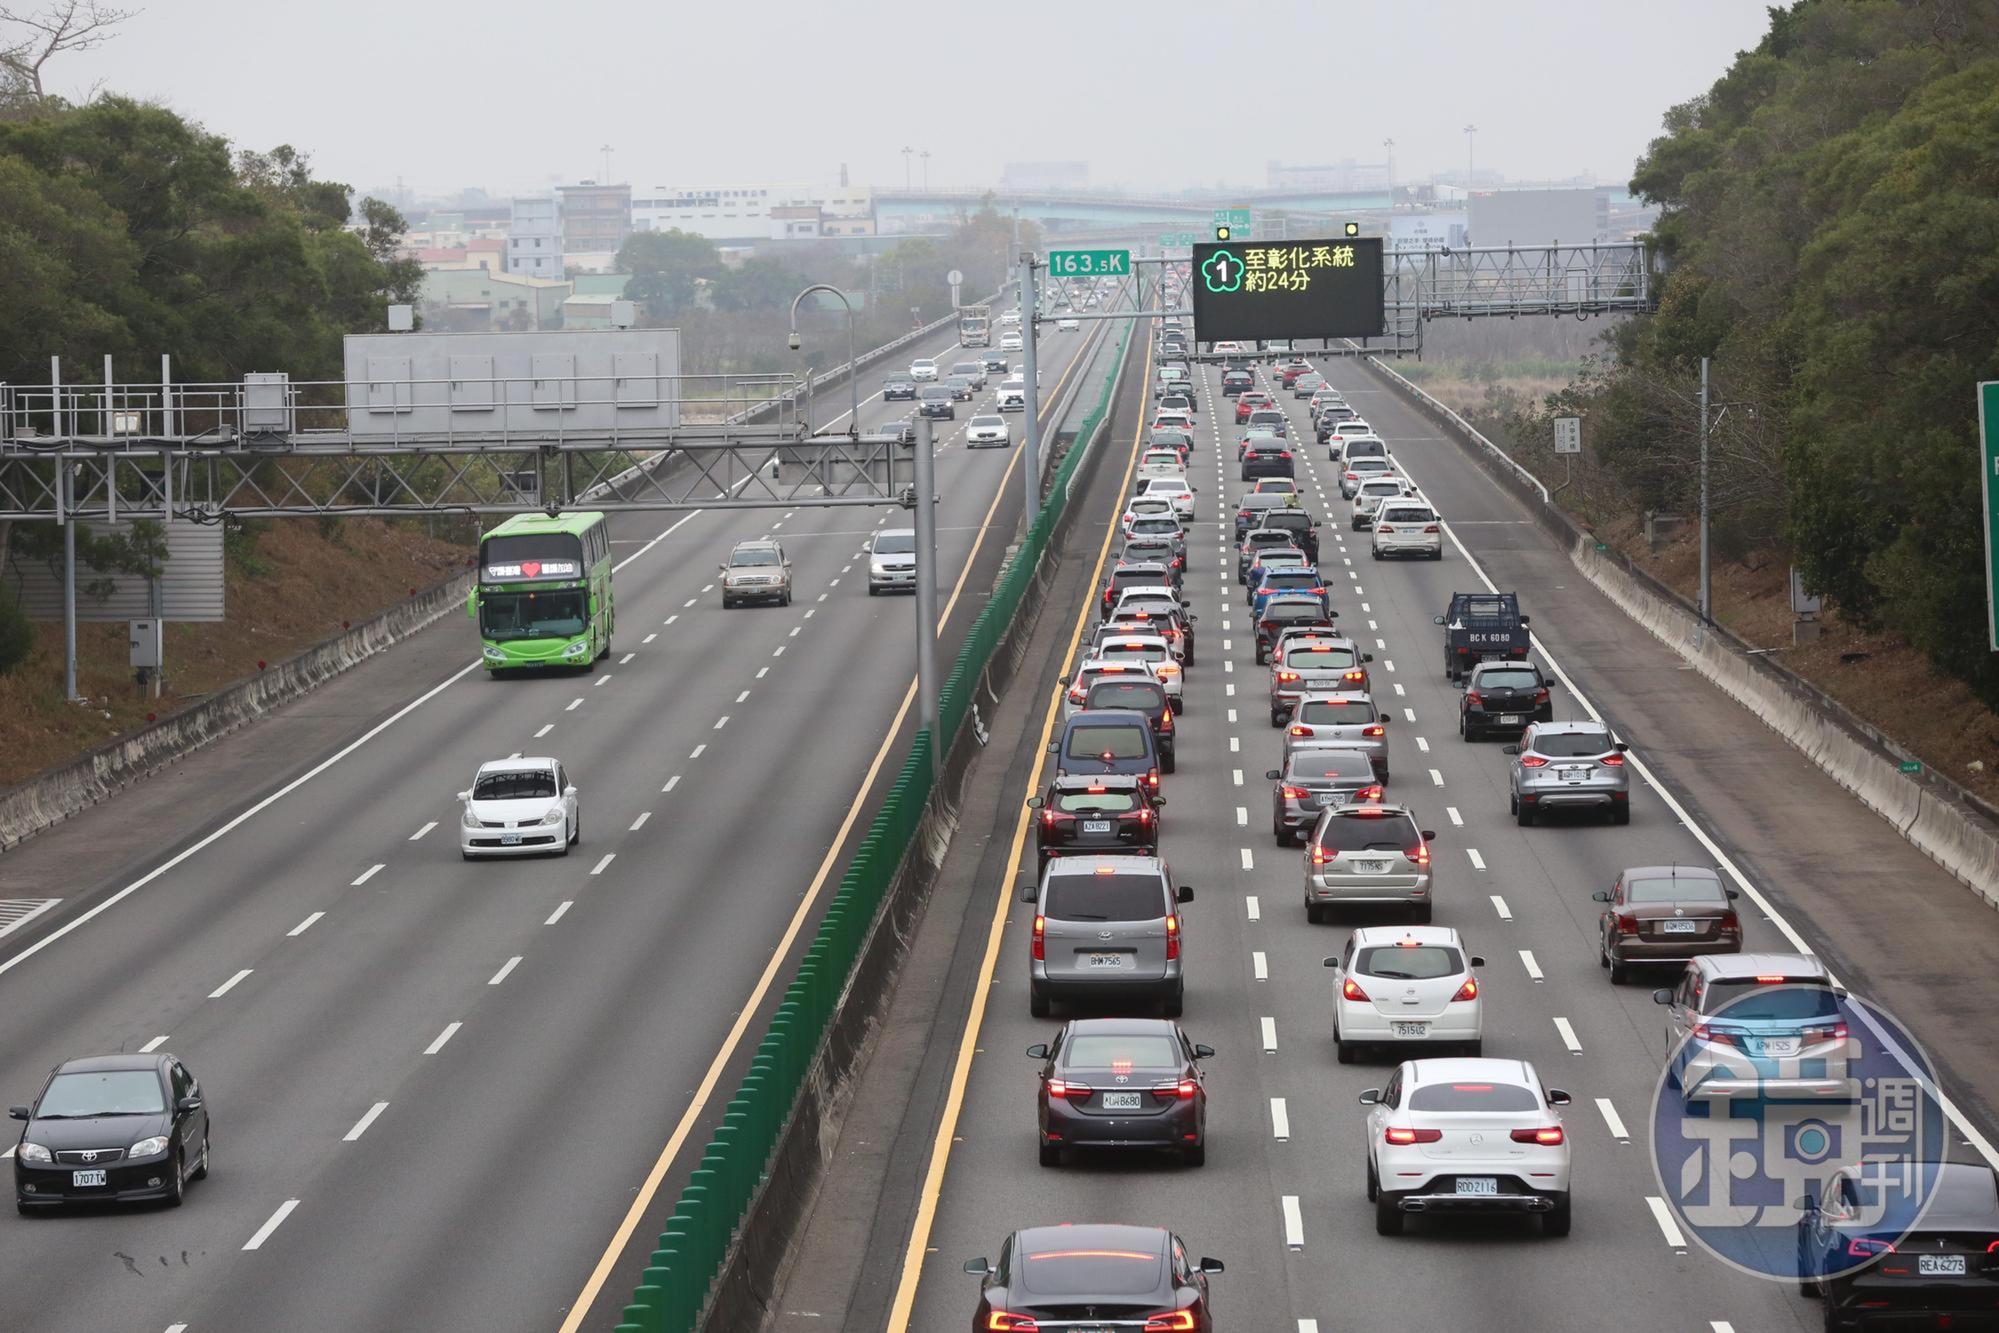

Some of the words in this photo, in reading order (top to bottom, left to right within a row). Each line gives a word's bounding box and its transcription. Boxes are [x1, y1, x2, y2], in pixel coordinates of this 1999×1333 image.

[1055, 254, 1122, 272] 163.5K
[1245, 245, 1355, 270] 至彰化系統
[1216, 260, 1227, 282] 1
[1245, 269, 1311, 292] 約24分
[1490, 633, 1510, 642] 6080
